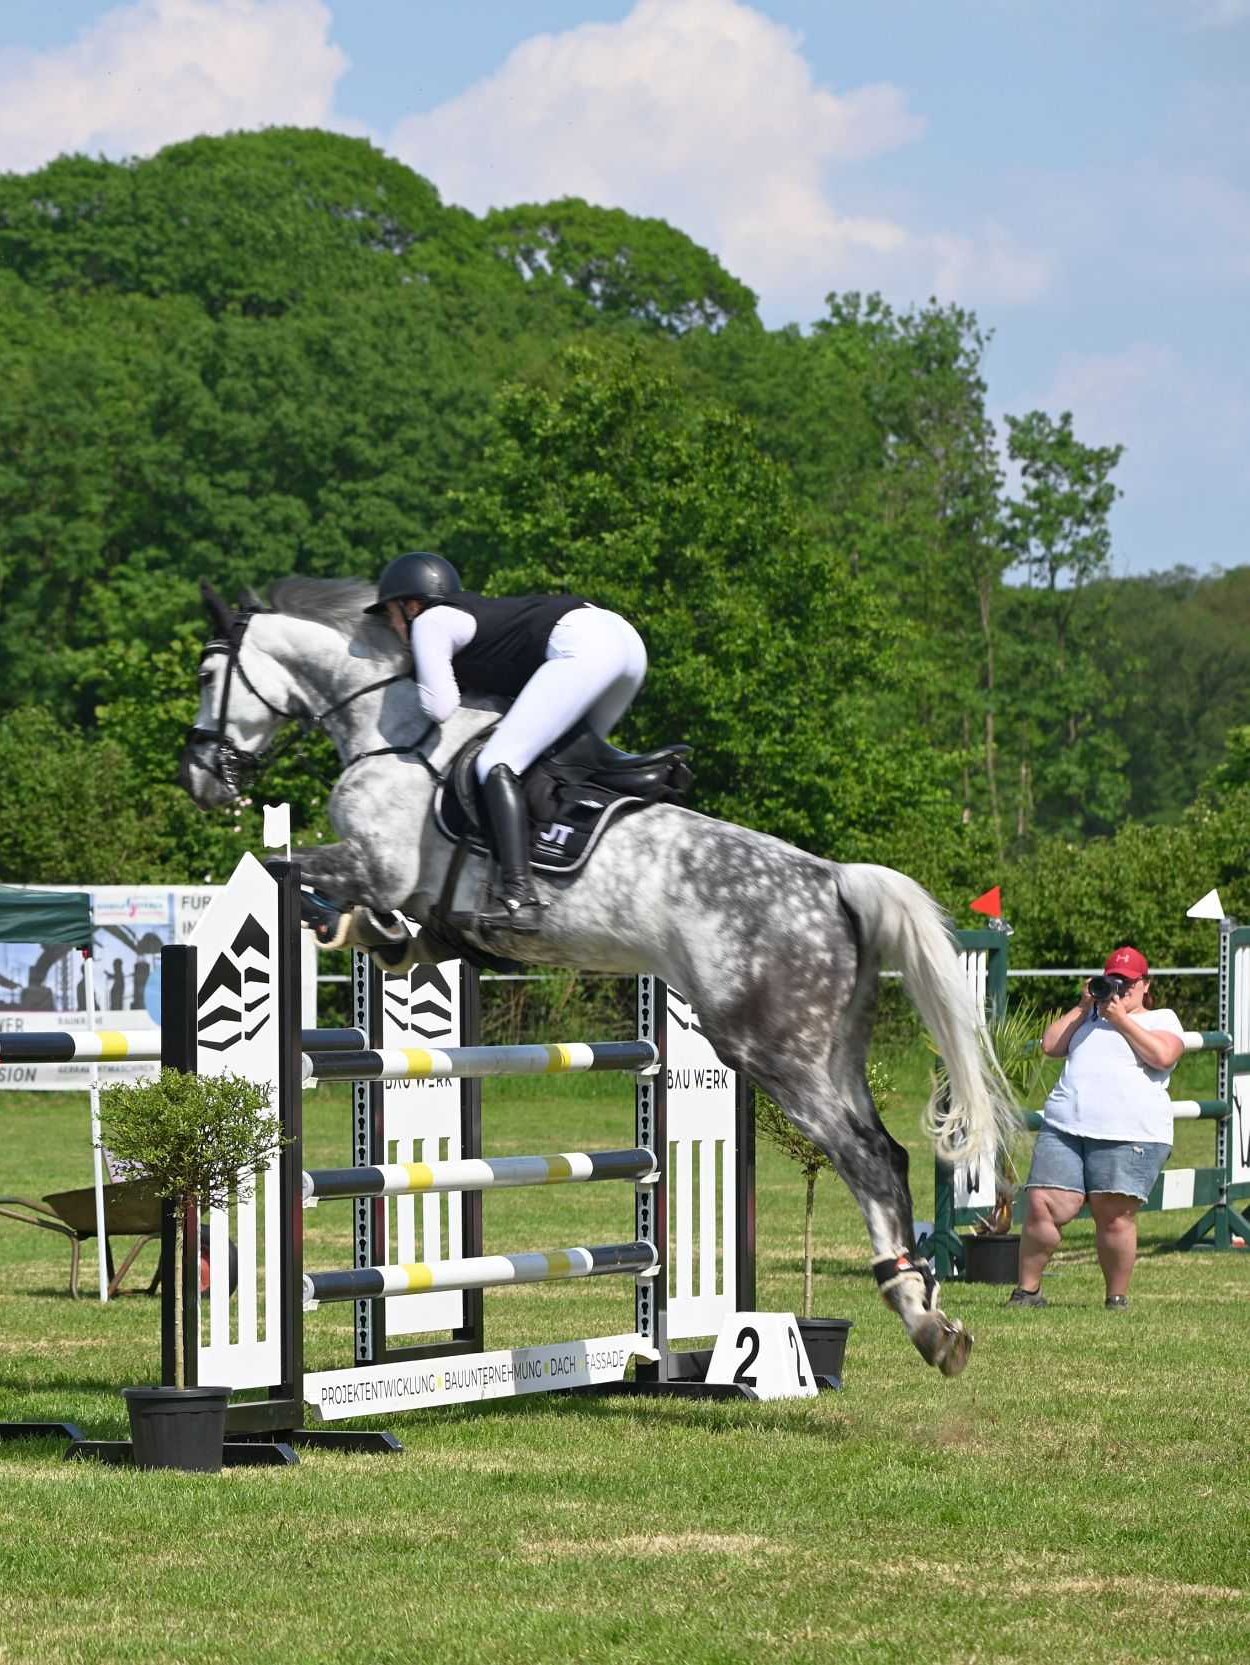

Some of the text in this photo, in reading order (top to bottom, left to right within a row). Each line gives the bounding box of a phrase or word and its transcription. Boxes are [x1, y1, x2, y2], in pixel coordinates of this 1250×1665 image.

[540, 822, 575, 846] JT
[667, 1069, 729, 1090] BAU WERK
[321, 1349, 625, 1405] PROJEKTENTWICKLUNG BAUUNTERNEHMUNG DACH FASSADE
[733, 1326, 808, 1388] 2 2
